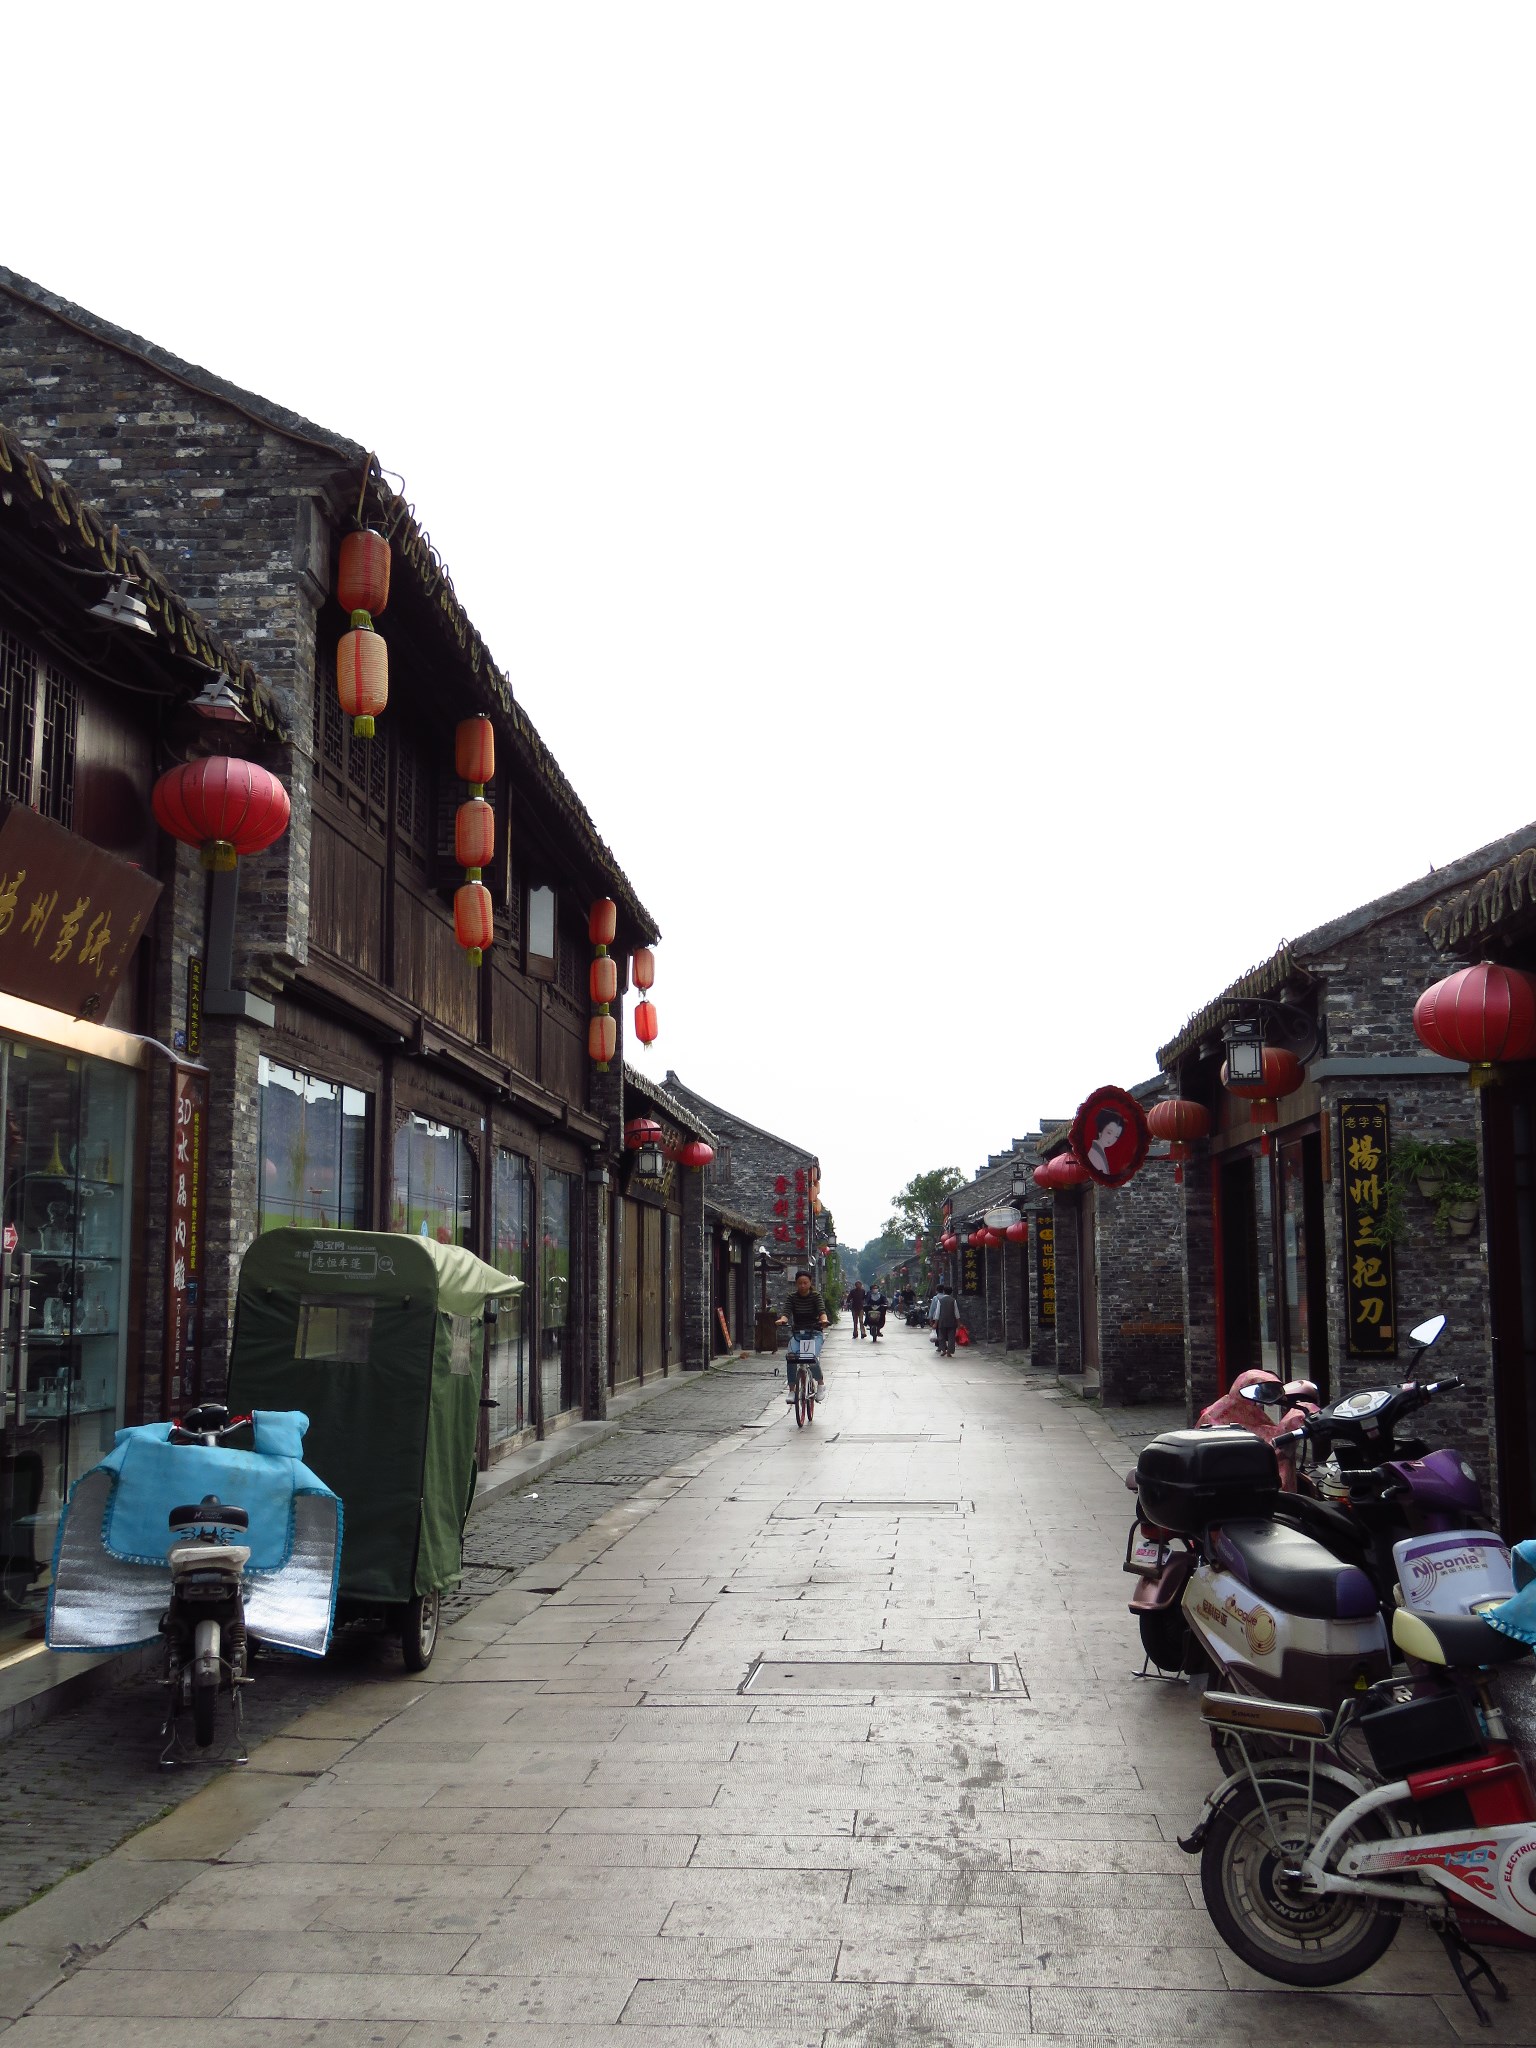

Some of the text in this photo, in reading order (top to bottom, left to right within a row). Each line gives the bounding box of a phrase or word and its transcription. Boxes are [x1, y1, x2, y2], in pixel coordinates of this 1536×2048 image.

[1344, 1115, 1383, 1129] 老字号
[313, 1240, 345, 1251] 淘宝网
[1412, 1553, 1479, 1578] Niconia
